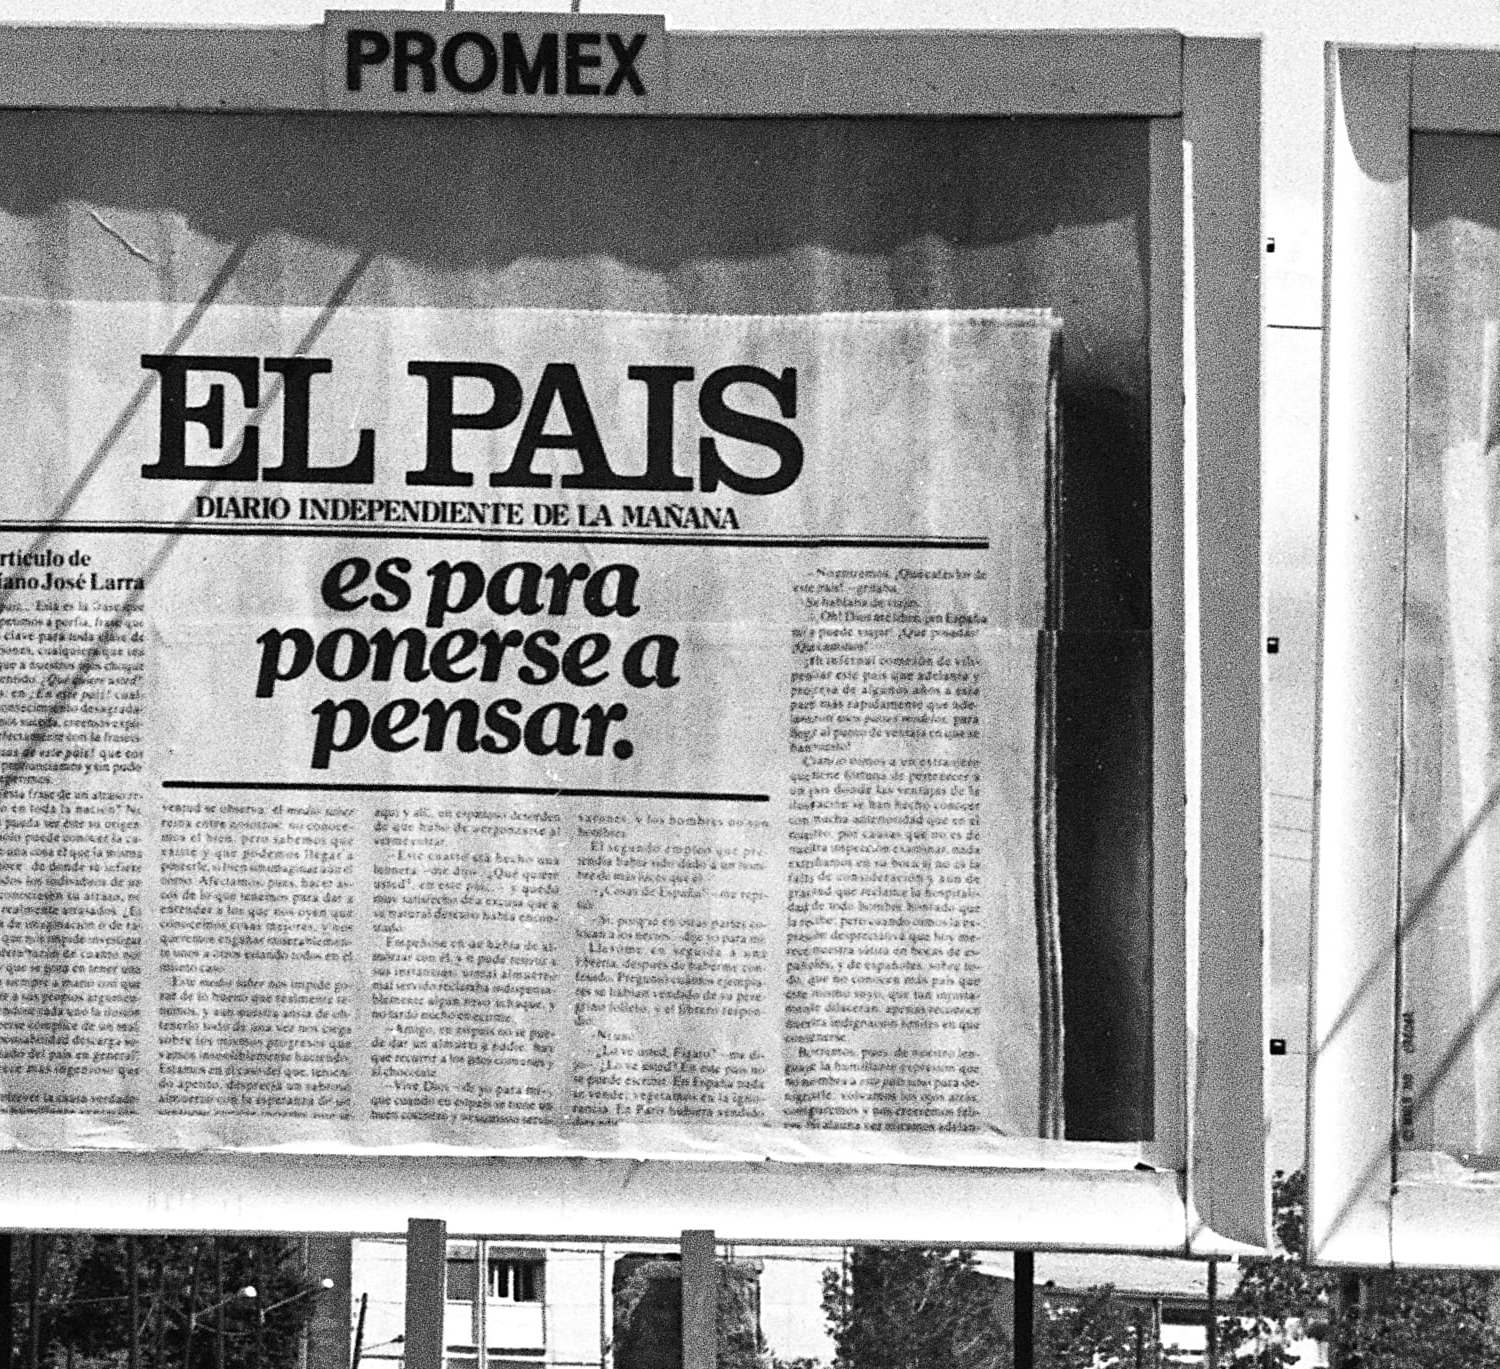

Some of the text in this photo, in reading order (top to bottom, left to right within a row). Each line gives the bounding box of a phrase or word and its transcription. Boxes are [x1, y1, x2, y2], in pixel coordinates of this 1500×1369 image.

[346, 29, 648, 97] PROMEX
[140, 353, 804, 496] EL PAIS
[195, 496, 740, 530] DIARIO INDEPENDIENTE DE LA MAÑANA
[40, 572, 87, 590] José
[90, 573, 145, 591] Larra
[68, 550, 91, 567] de
[320, 557, 640, 628] es para
[256, 628, 680, 698] ponerse a
[311, 698, 636, 769] pensar.
